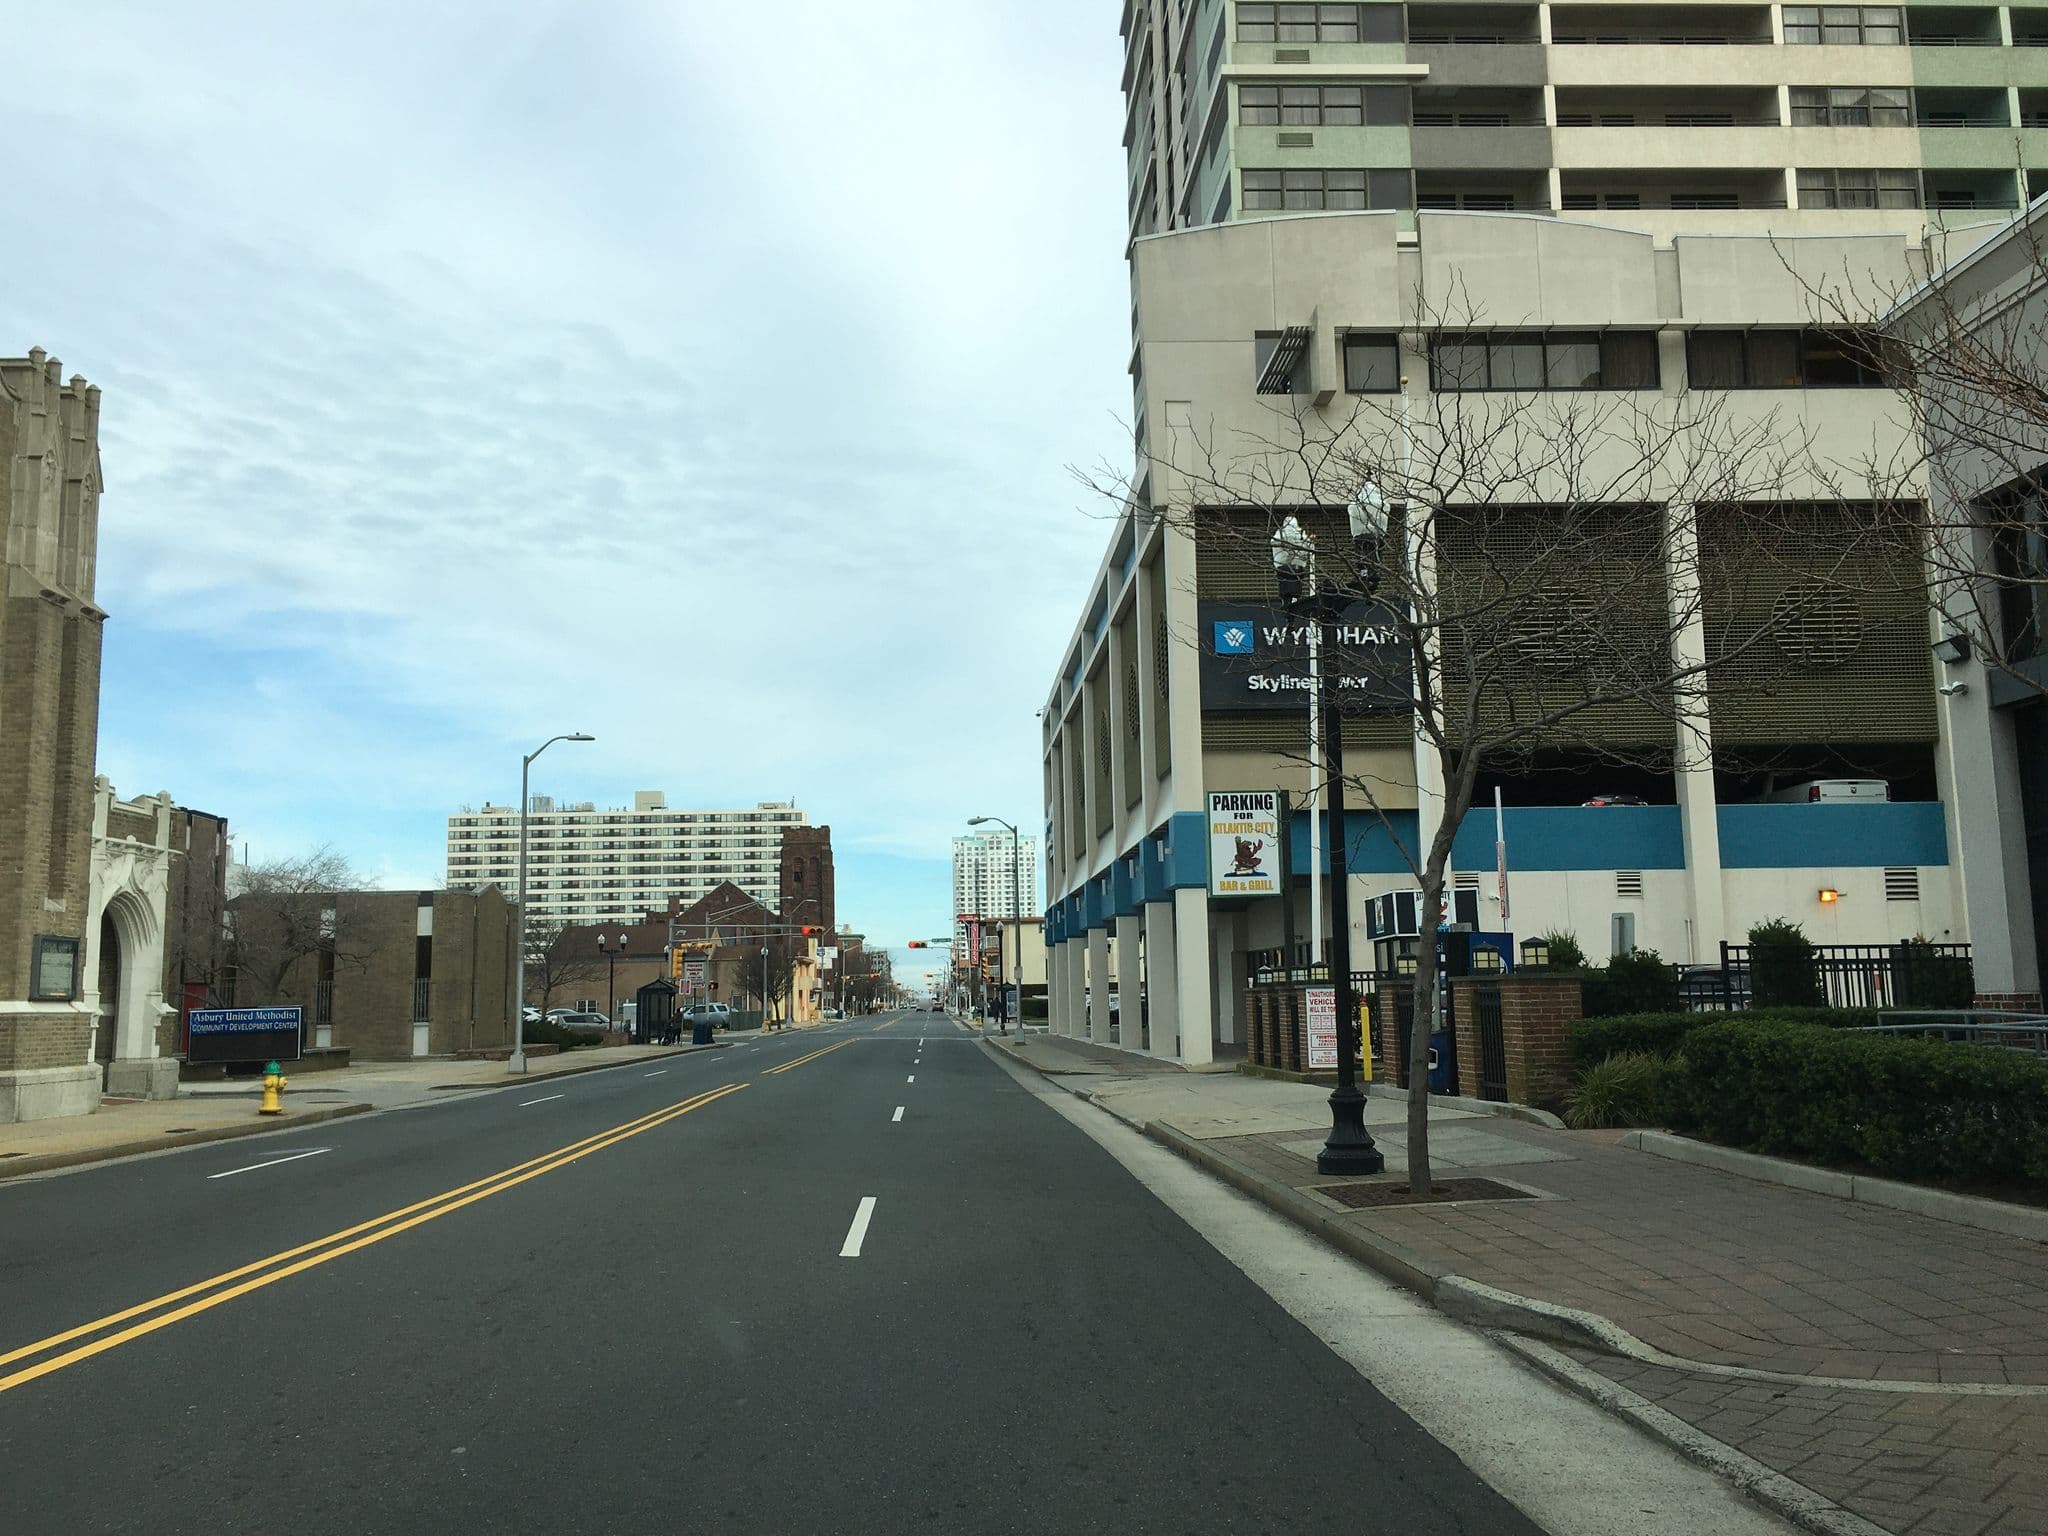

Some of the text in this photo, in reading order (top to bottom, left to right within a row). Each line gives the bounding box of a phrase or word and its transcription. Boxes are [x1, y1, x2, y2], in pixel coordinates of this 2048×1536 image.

[1247, 674, 1311, 692] Skyline
[1212, 794, 1273, 811] PARKING
[1233, 812, 1254, 820] FOR
[1213, 821, 1275, 834] ATLANTIC CITY
[1219, 879, 1273, 891] BAR & GRILL
[194, 1010, 296, 1023] Asbury United Methodist
